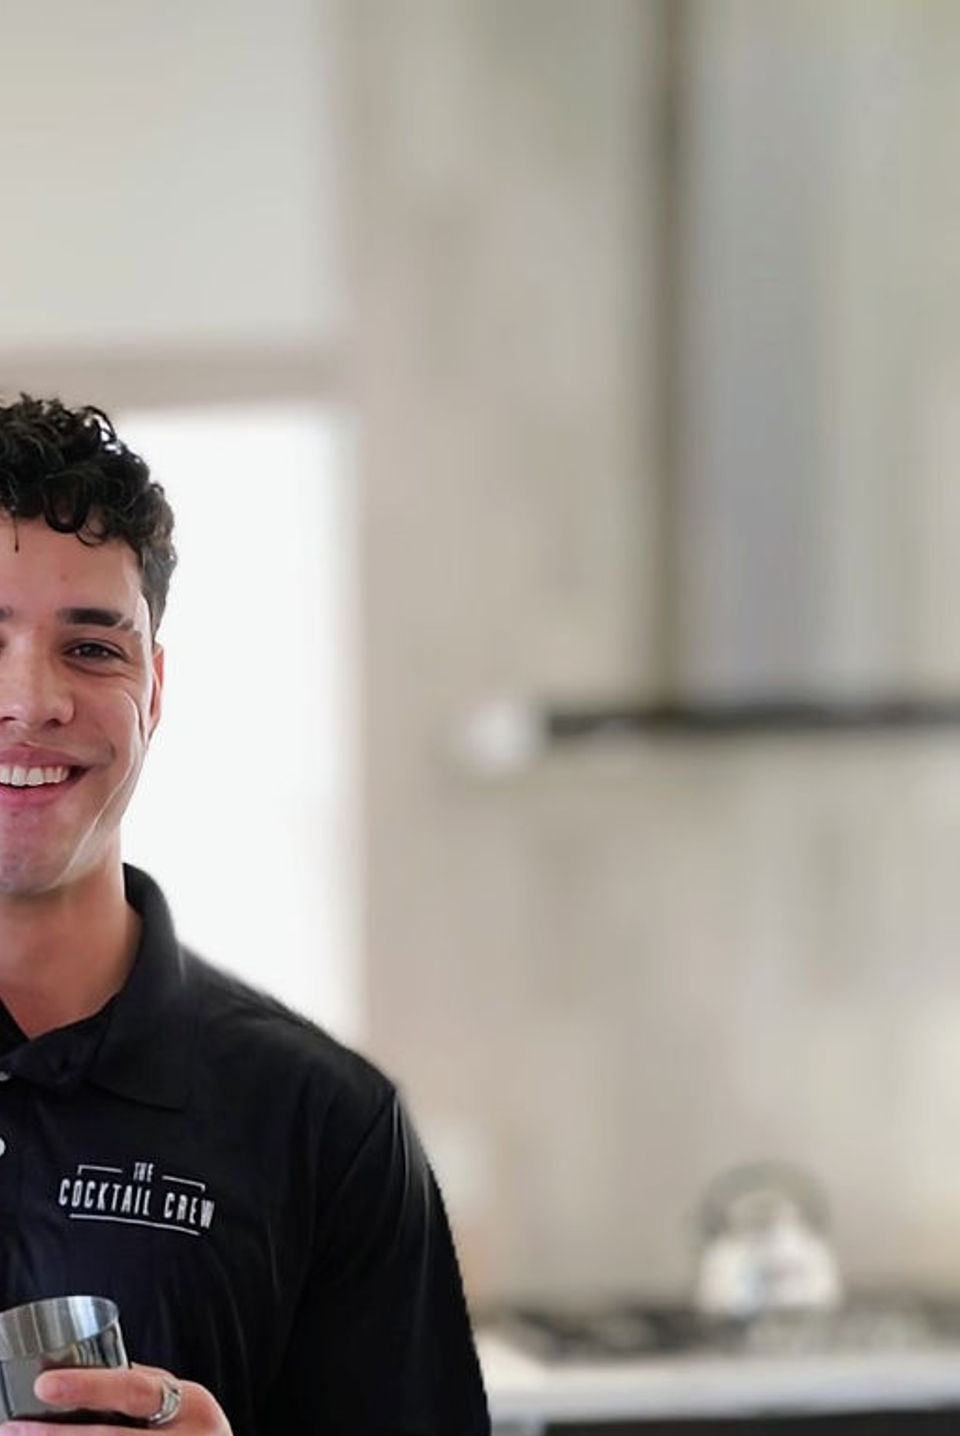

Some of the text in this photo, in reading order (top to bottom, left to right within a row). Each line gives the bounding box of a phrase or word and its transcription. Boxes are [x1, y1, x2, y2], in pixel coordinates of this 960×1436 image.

[132, 1162, 155, 1182] THE
[58, 1178, 216, 1229] COCKTAIL CREW
